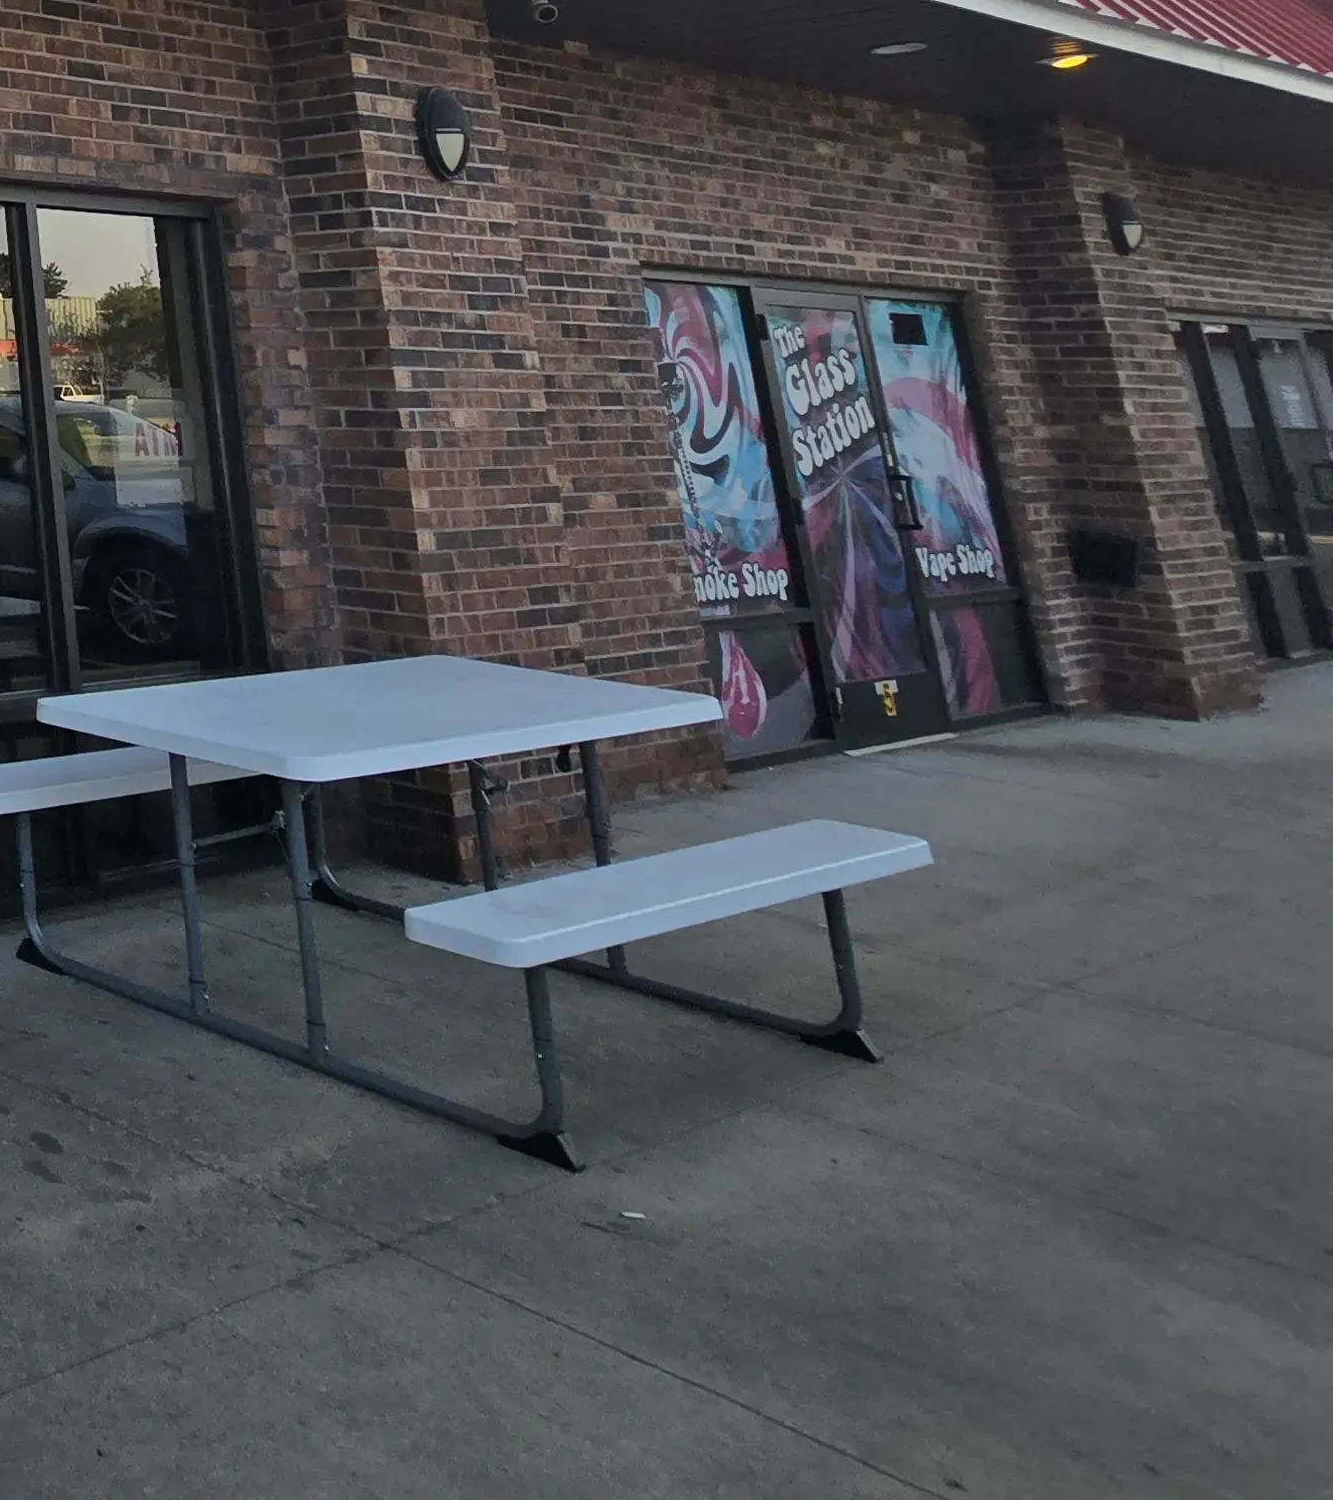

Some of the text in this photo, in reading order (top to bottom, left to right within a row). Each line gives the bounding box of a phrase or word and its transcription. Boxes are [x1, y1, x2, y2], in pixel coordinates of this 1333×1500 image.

[774, 326, 805, 358] The
[785, 349, 856, 416] Glass
[793, 396, 875, 477] Station
[742, 563, 789, 601] Shop
[915, 544, 995, 582] Vape Shop
